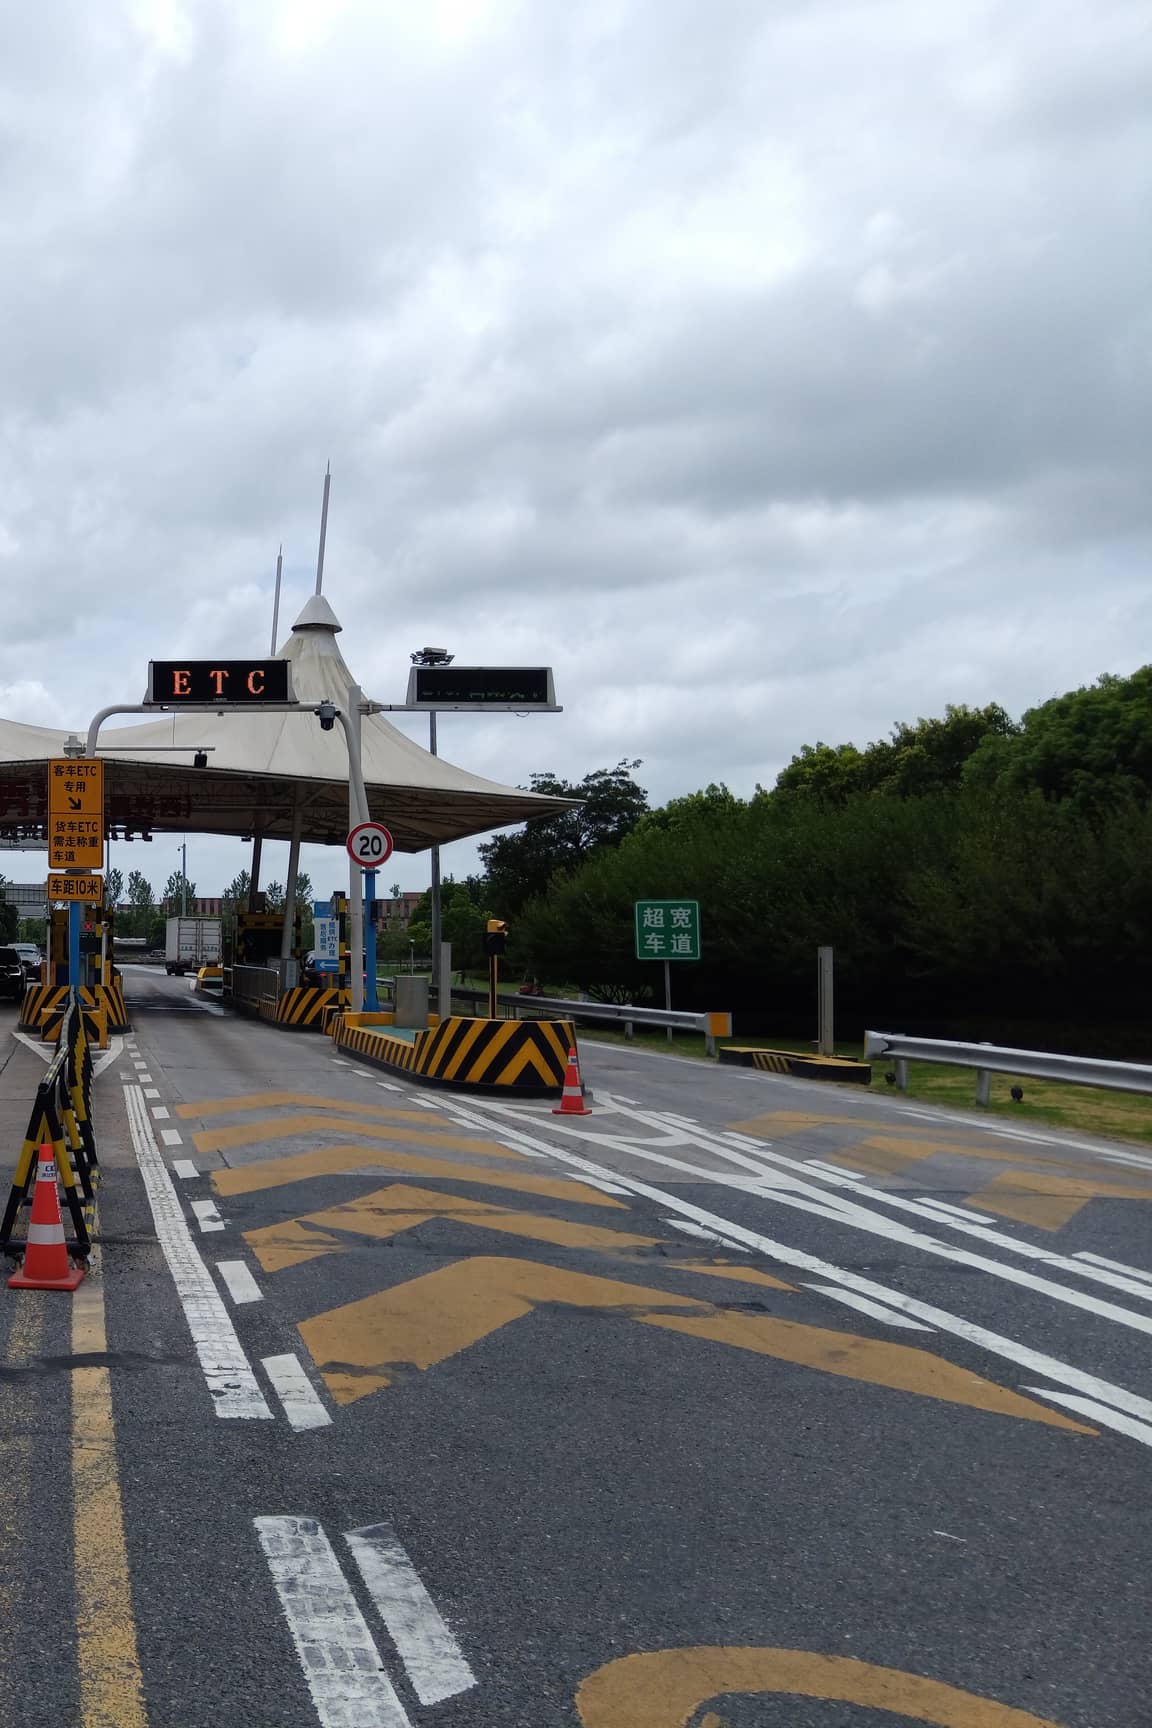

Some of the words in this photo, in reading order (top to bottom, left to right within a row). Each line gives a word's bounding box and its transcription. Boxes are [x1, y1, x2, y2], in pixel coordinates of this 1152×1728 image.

[54, 765, 97, 777] 客车ETC
[64, 781, 86, 793] 专用
[55, 821, 98, 833] 货车ETC
[54, 836, 99, 848] 需走称重
[359, 835, 382, 856] 20
[54, 850, 76, 862] 车道
[51, 880, 98, 895] 车距10米
[642, 907, 692, 928] 超宽
[643, 932, 693, 953] 车道
